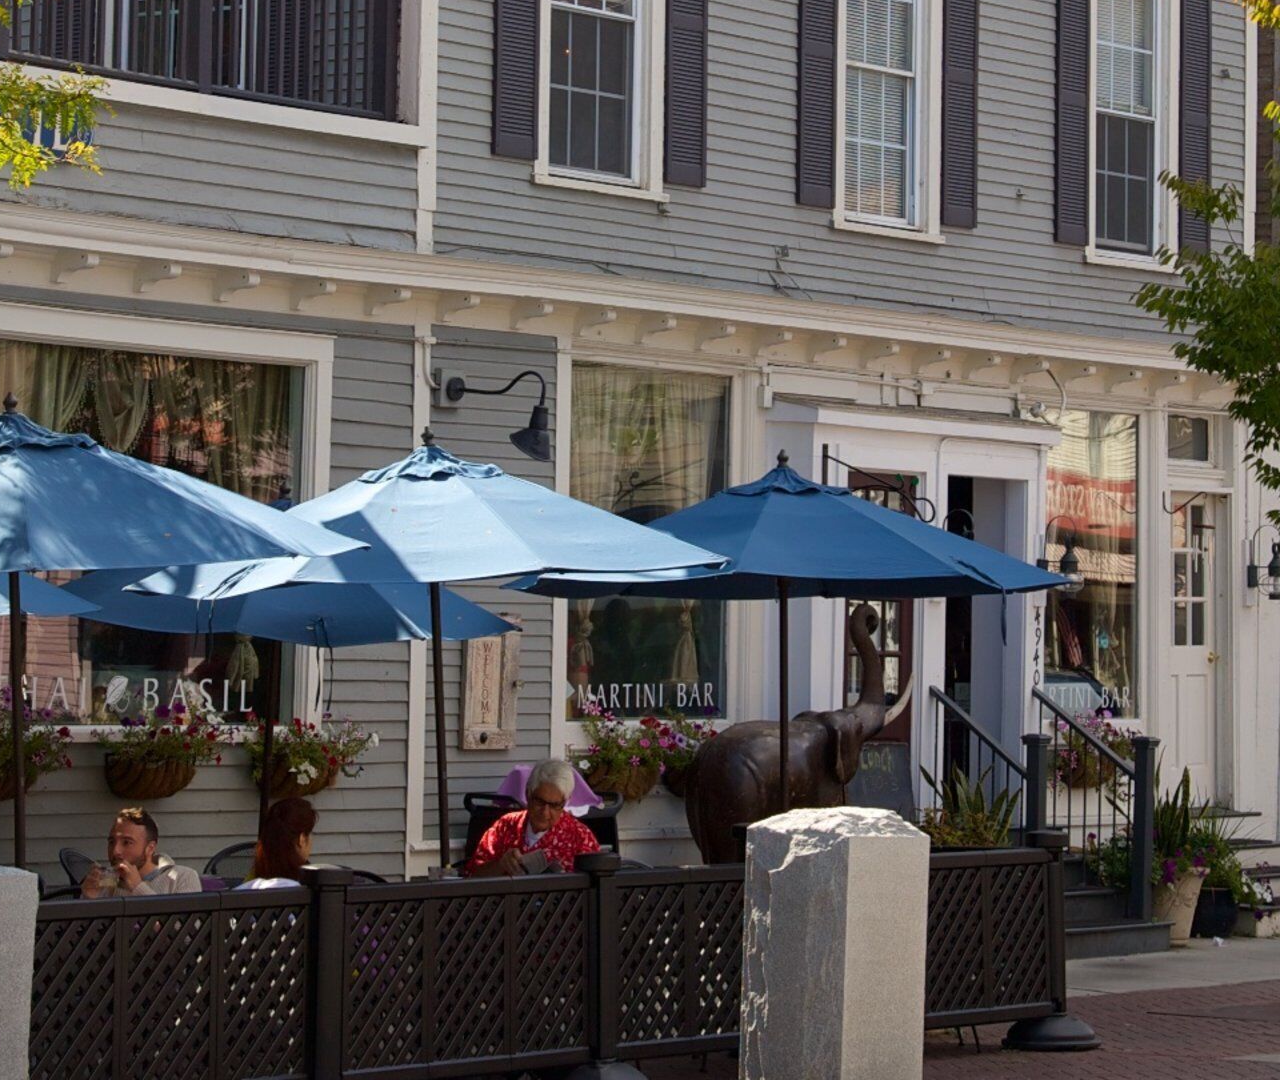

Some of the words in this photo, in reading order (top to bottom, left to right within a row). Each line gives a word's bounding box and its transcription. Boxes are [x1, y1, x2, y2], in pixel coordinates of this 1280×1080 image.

[1033, 607, 1043, 686] 4940
[143, 677, 253, 713] BASIL
[577, 683, 663, 708] MARTINI
[676, 682, 715, 708] BAR
[1048, 686, 1091, 709] RTINI
[1101, 686, 1131, 709] BAR
